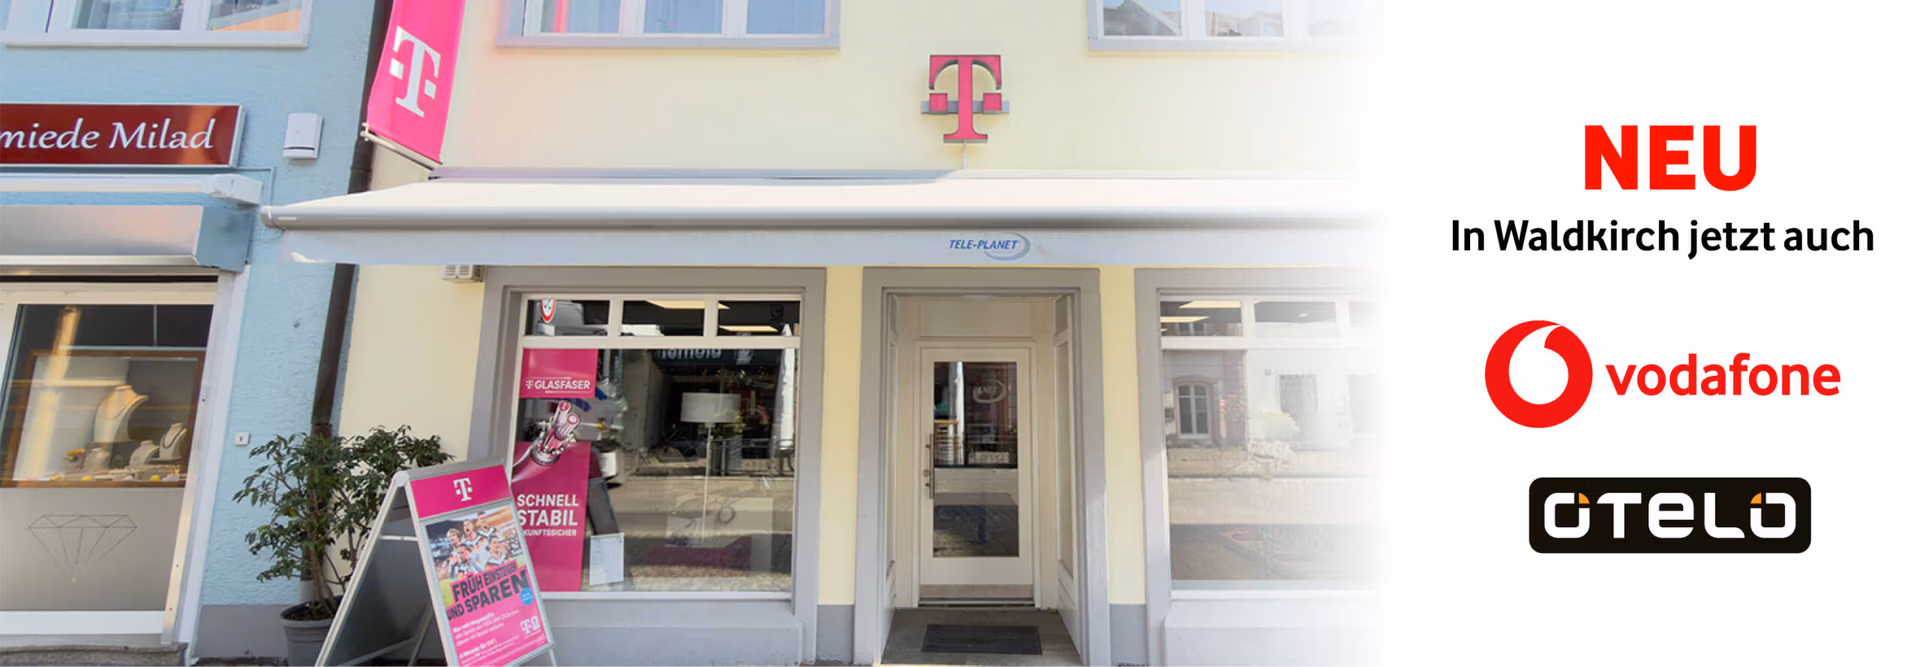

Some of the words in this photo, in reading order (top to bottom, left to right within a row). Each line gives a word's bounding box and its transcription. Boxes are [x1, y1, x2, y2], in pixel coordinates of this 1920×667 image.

[389, 25, 441, 118] T
[929, 54, 1002, 144] T
[109, 118, 216, 149] Milad
[949, 239, 1019, 250] TELE-PLANET
[534, 380, 592, 390] GLASFASER
[453, 477, 473, 502] T
[517, 494, 579, 507] SCHNELL
[518, 509, 578, 526] STABIL
[452, 575, 484, 602] FRÜH
[464, 569, 530, 613] SPAREN
